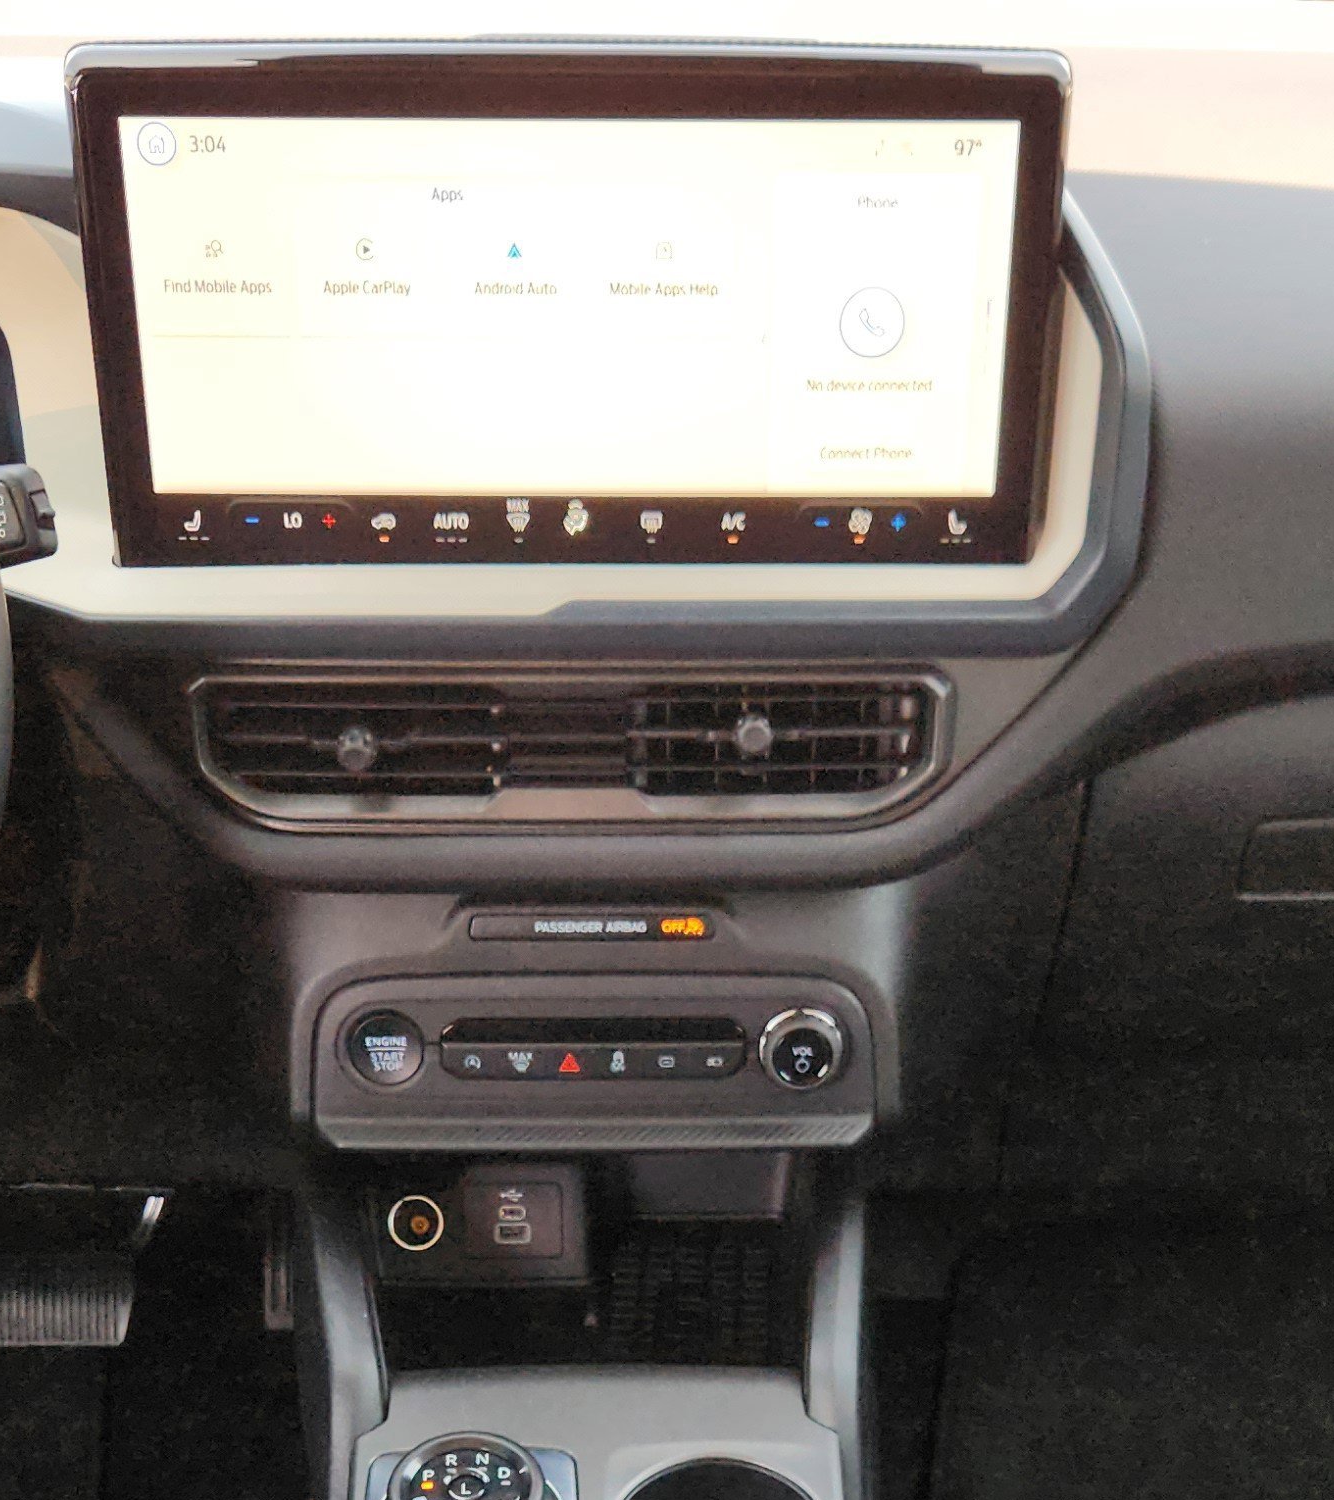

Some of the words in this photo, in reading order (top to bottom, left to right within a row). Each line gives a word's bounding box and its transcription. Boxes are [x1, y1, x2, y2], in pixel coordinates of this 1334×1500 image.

[189, 135, 227, 154] 3:04
[431, 186, 464, 203] Apps
[857, 194, 900, 209] Phone
[163, 278, 192, 293] Find
[194, 279, 237, 294] Mobile
[240, 279, 273, 297] Apps
[323, 280, 361, 296] Apple
[362, 280, 411, 297] CarPlay
[474, 281, 524, 296] Android
[527, 281, 558, 296] Auto
[609, 281, 652, 296] Mobile
[655, 281, 686, 297] Apps
[689, 282, 719, 297] Help
[806, 378, 823, 392] No
[826, 378, 865, 392] device
[868, 378, 933, 392] connected
[283, 511, 303, 529] LO
[433, 511, 470, 530] AUTO
[534, 920, 603, 934] PASSENGER
[605, 920, 648, 934] AIRBAG
[661, 918, 687, 934] OFF
[365, 1036, 408, 1047] ENGINE
[369, 1051, 405, 1062] START
[508, 1051, 533, 1062] MAX
[792, 1046, 814, 1057] VOL
[373, 1061, 404, 1072] STOP
[445, 1453, 458, 1467] R
[475, 1452, 490, 1466] N
[422, 1469, 435, 1482] P
[497, 1466, 511, 1480] D
[460, 1482, 472, 1495] L
